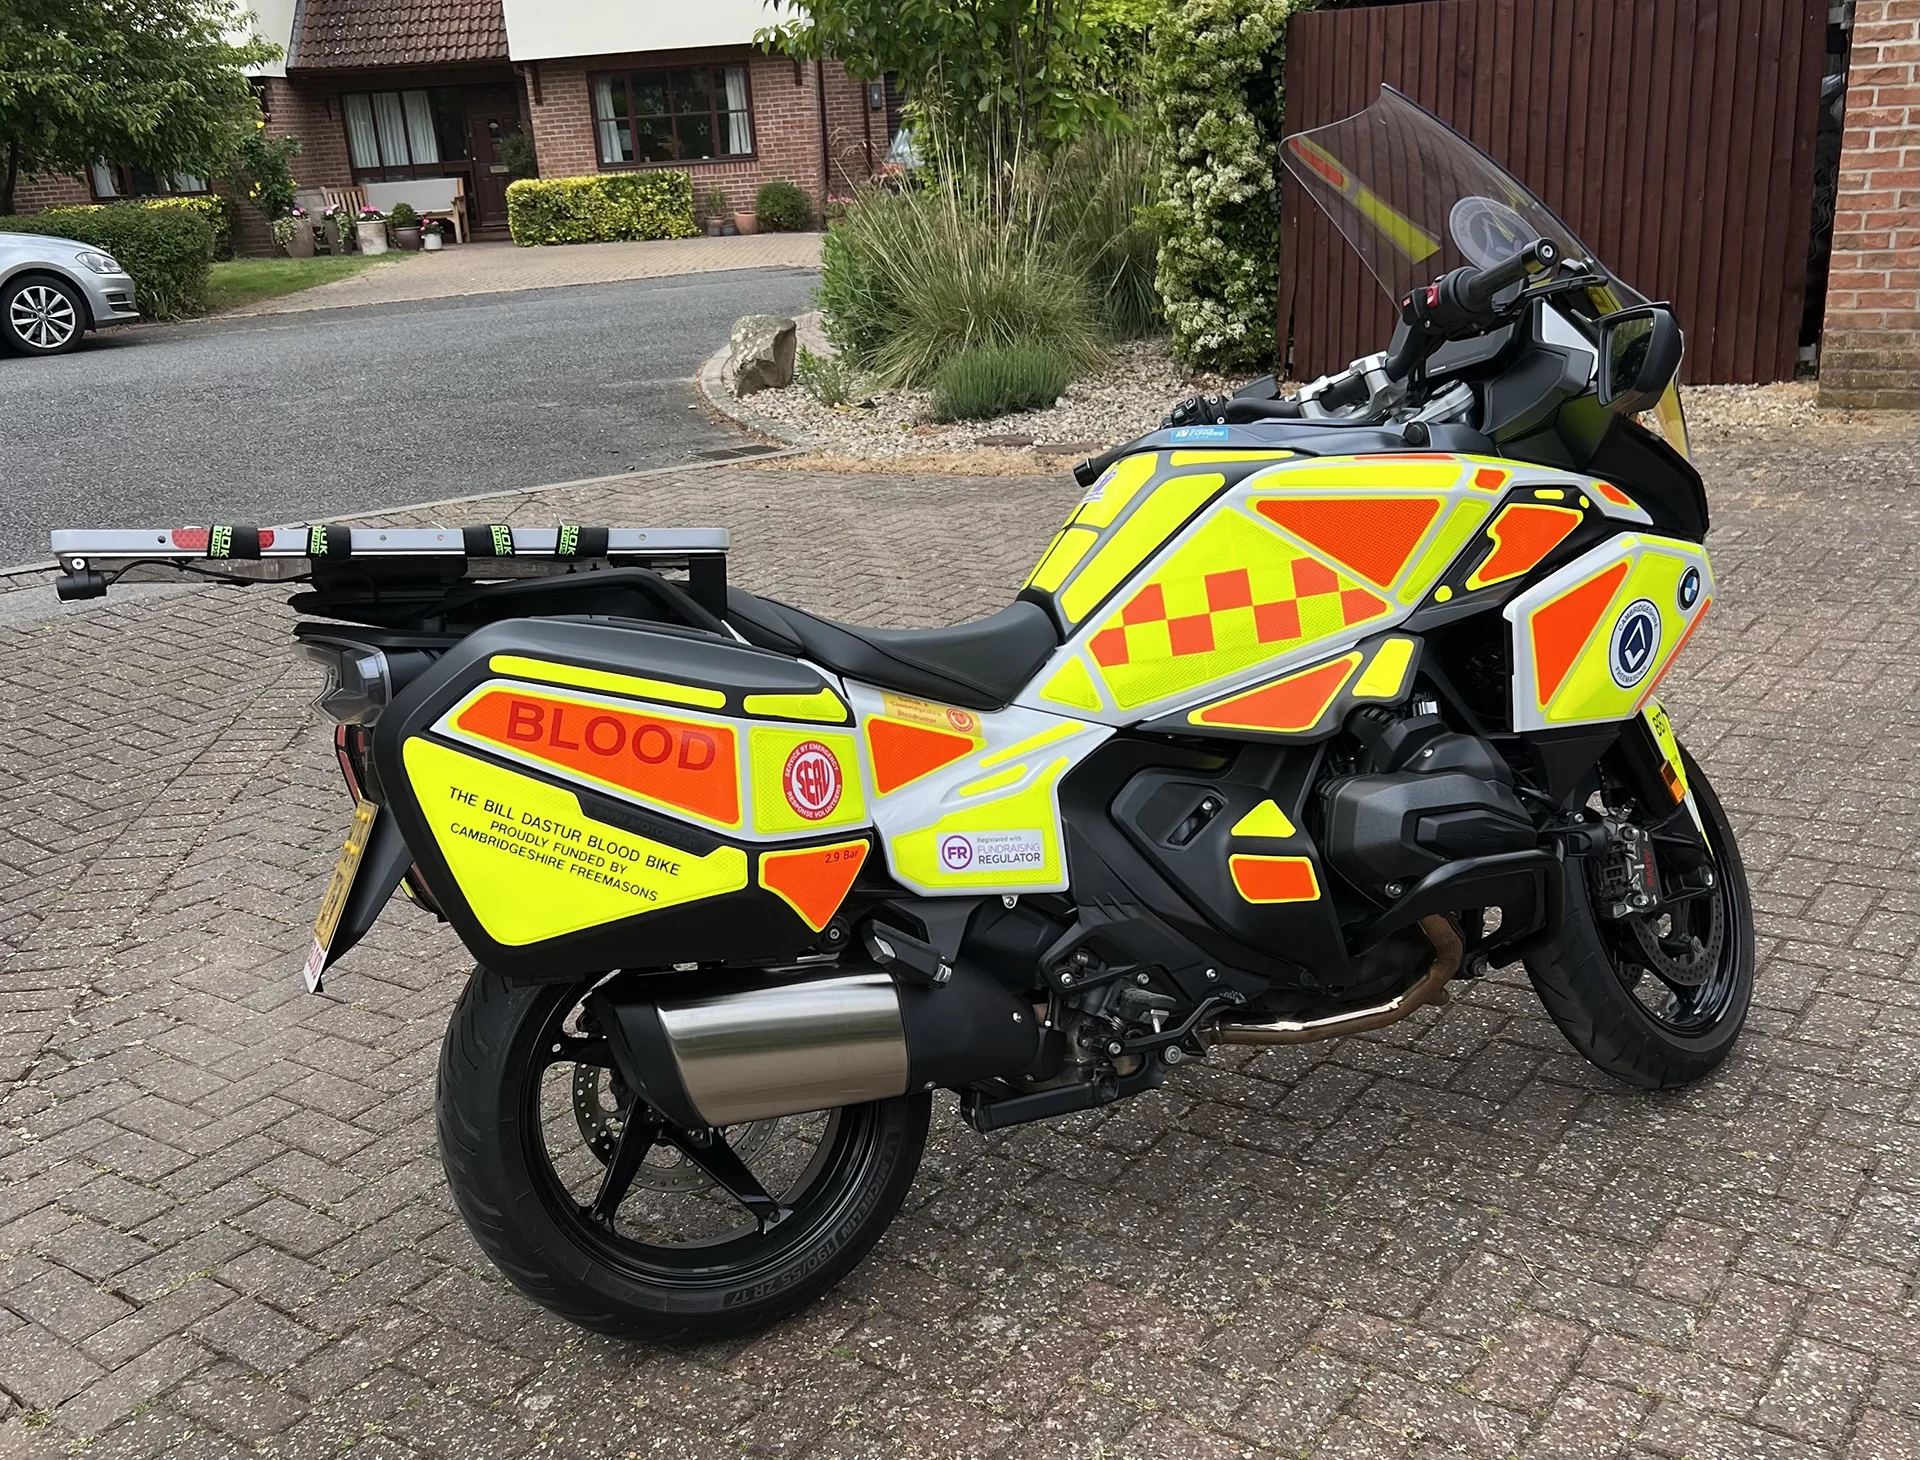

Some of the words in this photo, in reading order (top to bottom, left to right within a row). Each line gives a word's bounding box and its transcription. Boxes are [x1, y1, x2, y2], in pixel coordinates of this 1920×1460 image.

[220, 526, 233, 558] ROK
[499, 525, 513, 555] ROK
[567, 526, 579, 556] ROK
[1618, 604, 1658, 631] CAMBRIDGESHIRE
[1615, 665, 1647, 682] FREEMASONS
[507, 700, 716, 771] BLOOD
[785, 751, 801, 778] SERVICE
[800, 745, 808, 753] BY
[809, 743, 839, 771] EMERGENCY
[796, 758, 830, 806] SERV
[787, 790, 814, 818] RESPONSE
[814, 784, 842, 819] VOLUNTEERS
[450, 786, 478, 807] THE
[484, 799, 514, 820] BILL
[521, 812, 582, 843] DASTUR
[587, 835, 640, 862] BLOOD
[645, 855, 681, 876] BIKE
[450, 822, 566, 870] CAMBRIDGESHIRE
[570, 863, 659, 902] FREEMASONS
[490, 820, 550, 848] PROUDLY
[553, 842, 605, 868] FUNDED
[610, 861, 628, 875] BY
[825, 852, 840, 864] 2.9
[843, 849, 859, 860] Bar
[947, 846, 968, 860] FR
[977, 842, 1040, 854] FUNDRAISING
[978, 852, 1041, 865] REGULATOR
[840, 1160, 890, 1239] MICHELIN
[781, 1236, 836, 1283] 190/55
[730, 1290, 749, 1305] 17
[753, 1281, 776, 1298] ZR
